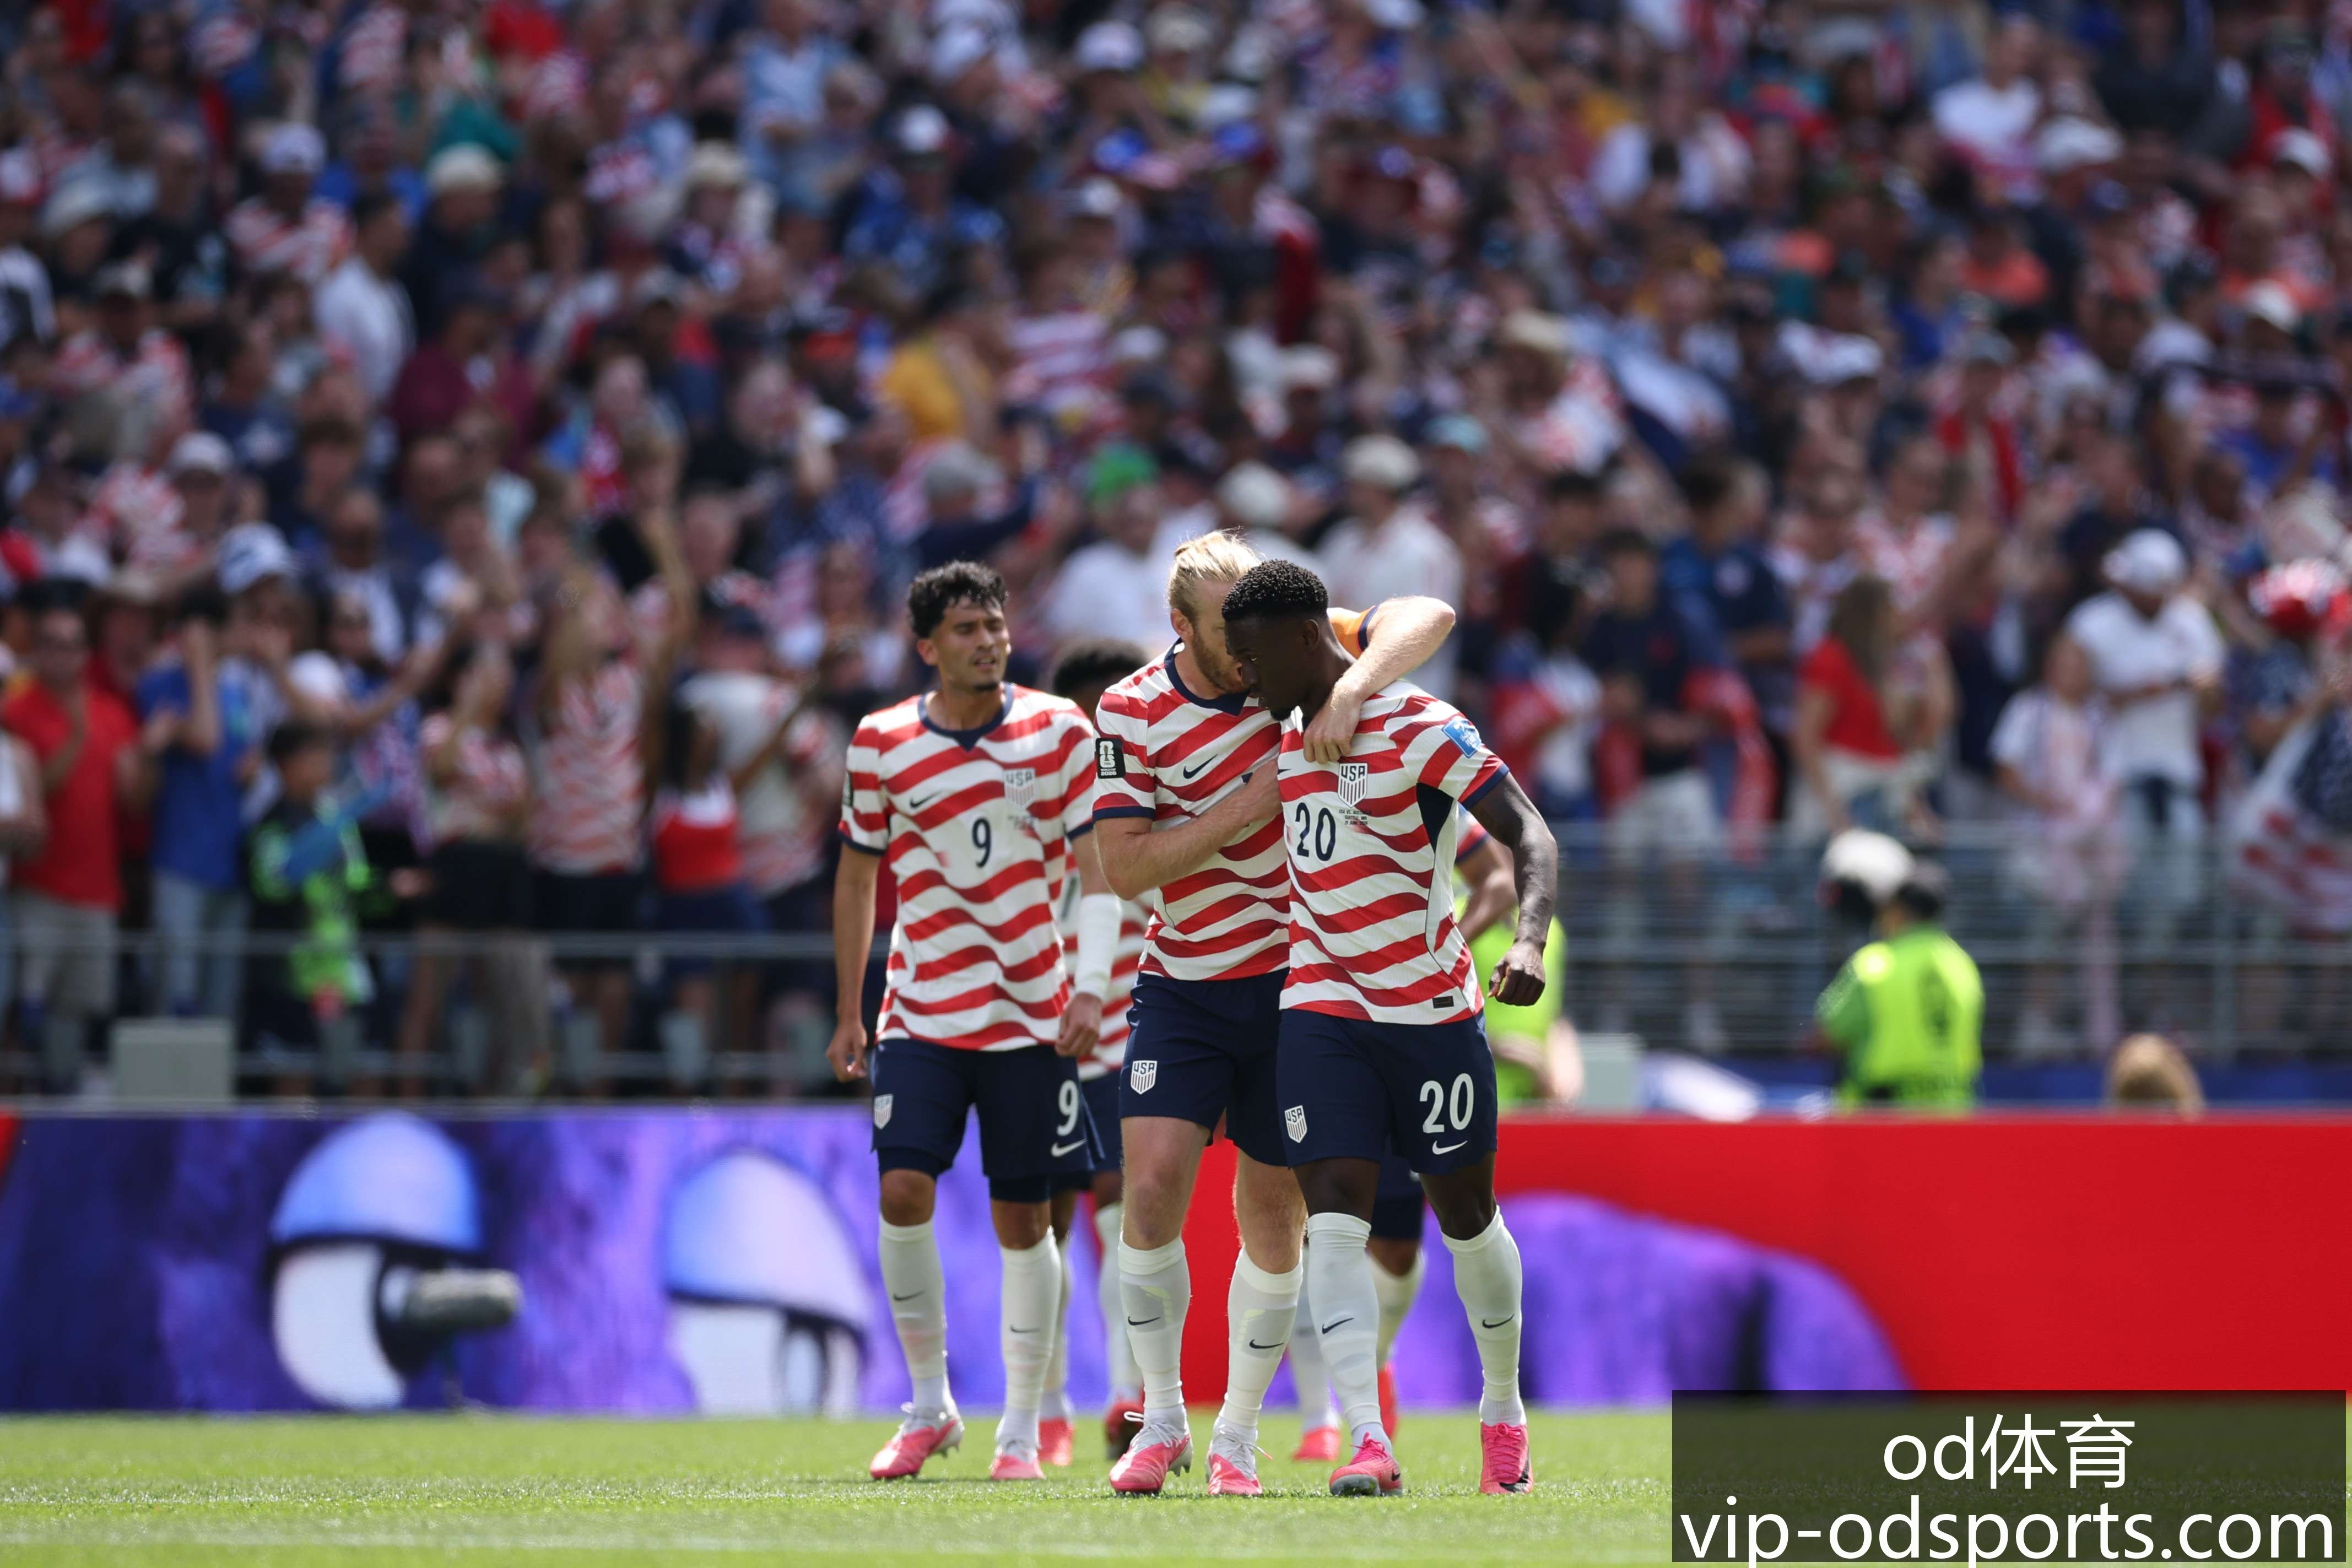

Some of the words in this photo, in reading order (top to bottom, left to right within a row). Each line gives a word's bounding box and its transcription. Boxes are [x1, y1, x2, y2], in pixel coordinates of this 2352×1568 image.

[1006, 770, 1032, 786] USA
[1341, 766, 1365, 781] USA
[972, 818, 991, 868] 9
[1295, 802, 1336, 861] 20
[1134, 1062, 1155, 1074] USA
[1056, 1079, 1079, 1136] 9
[1286, 1108, 1302, 1123] USA
[1419, 1073, 1474, 1133] 20
